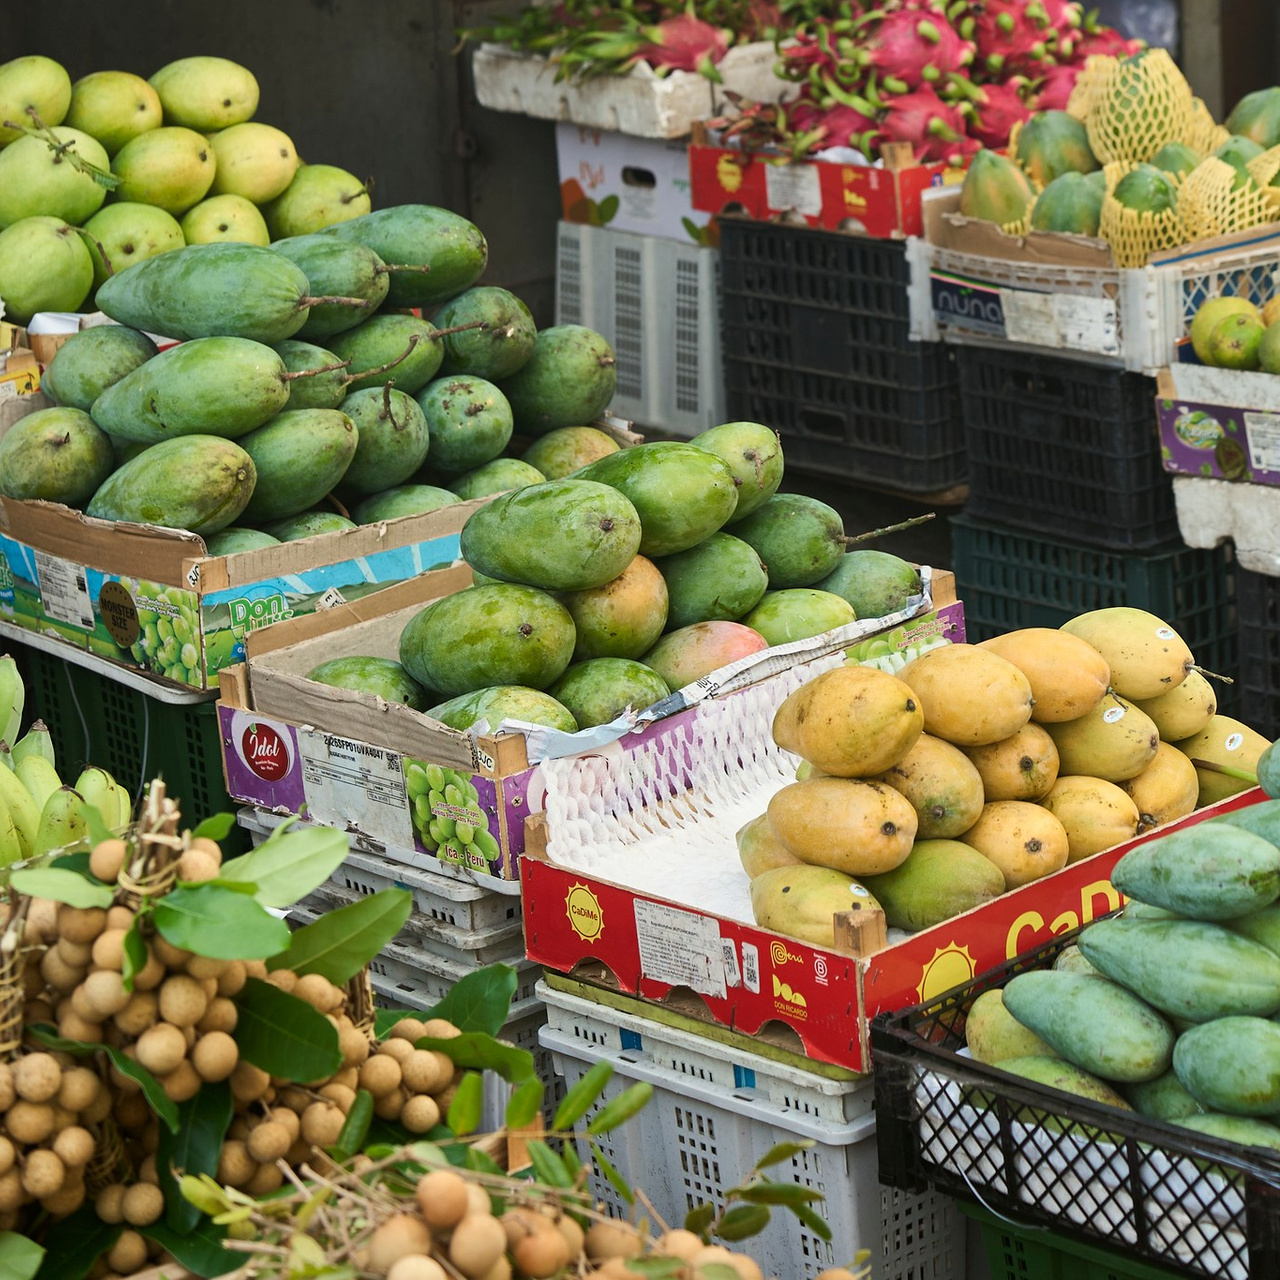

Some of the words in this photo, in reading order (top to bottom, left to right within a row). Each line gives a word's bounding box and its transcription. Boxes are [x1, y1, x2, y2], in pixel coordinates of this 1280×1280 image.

[101, 598, 135, 621] MONSTER
[229, 594, 284, 628] Don
[112, 615, 128, 631] SIZE
[249, 733, 280, 760] Idol
[477, 750, 493, 769] 3JC
[445, 844, 459, 860] Ica
[466, 848, 486, 869] Perú
[571, 904, 598, 921] CaDiMe
[1006, 879, 1133, 961] CaD
[774, 1000, 786, 1010] DON
[785, 1004, 809, 1019] RICARDO
